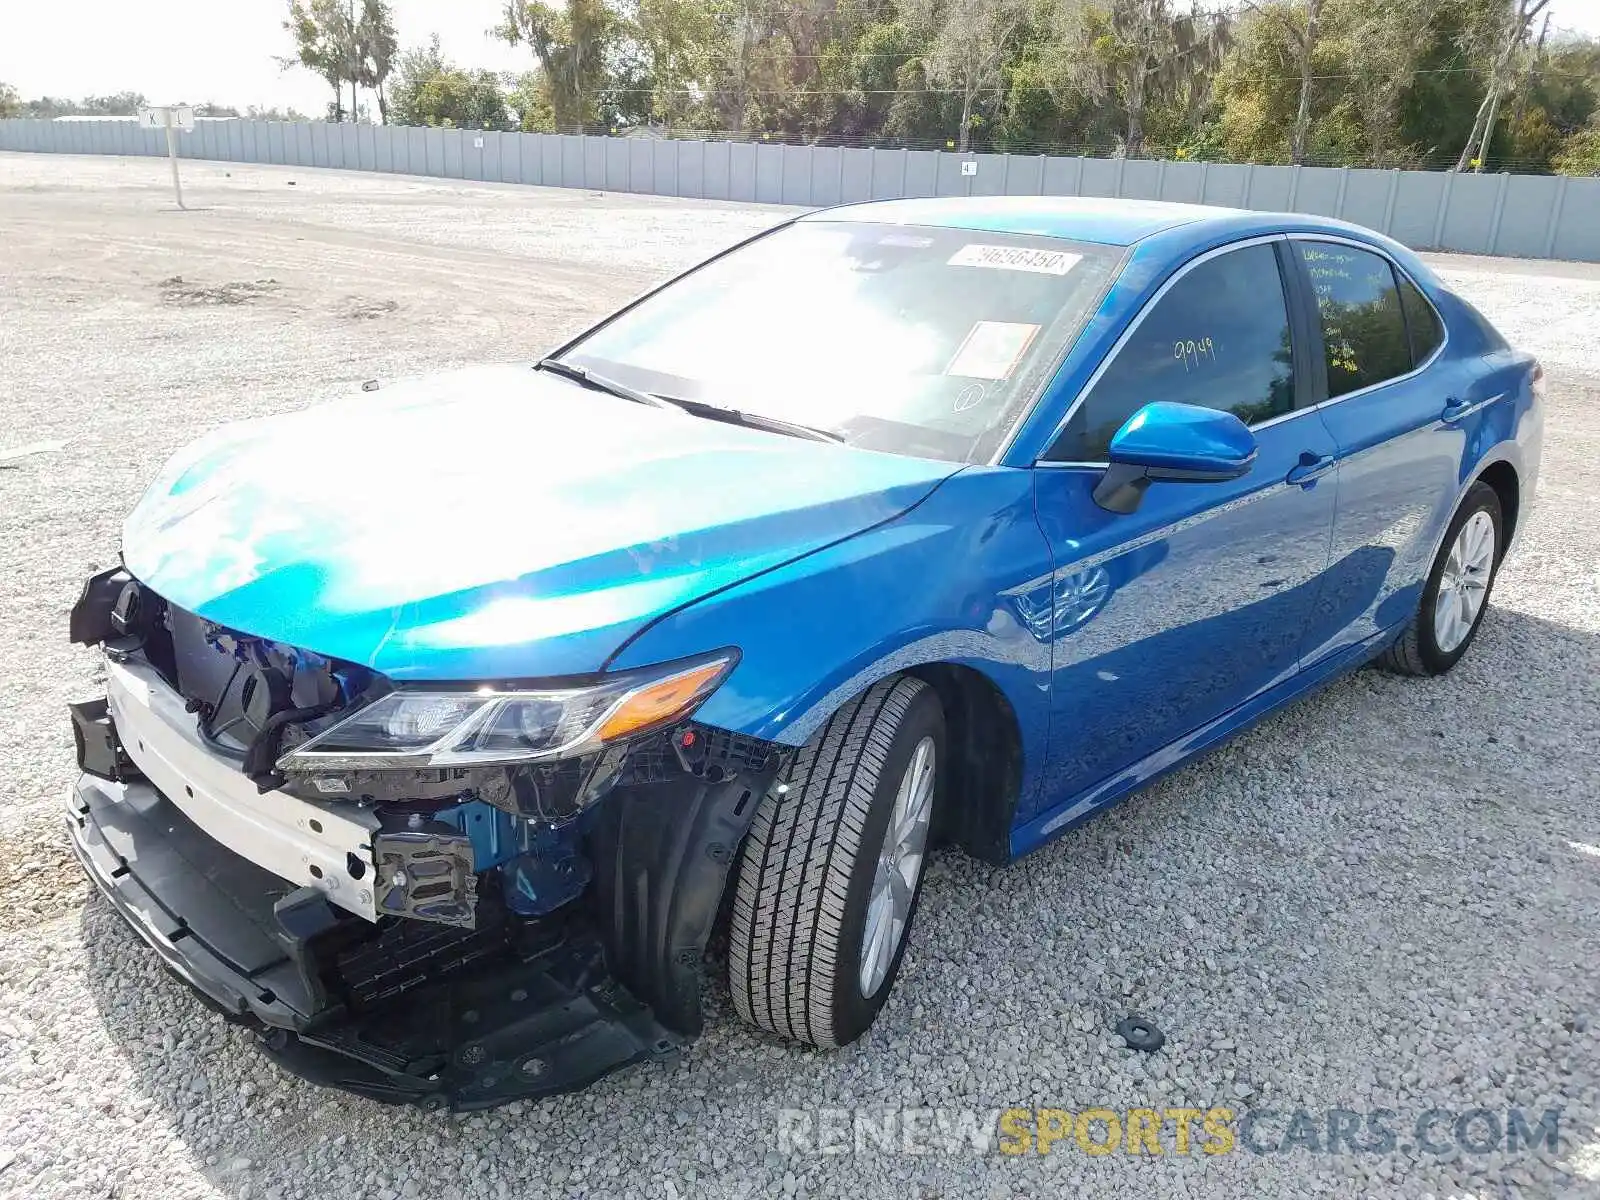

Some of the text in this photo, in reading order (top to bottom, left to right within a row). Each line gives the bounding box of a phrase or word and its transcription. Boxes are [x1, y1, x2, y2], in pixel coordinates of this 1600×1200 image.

[149, 112, 157, 125] K
[176, 111, 183, 125] L
[1174, 338, 1216, 372] 9949
